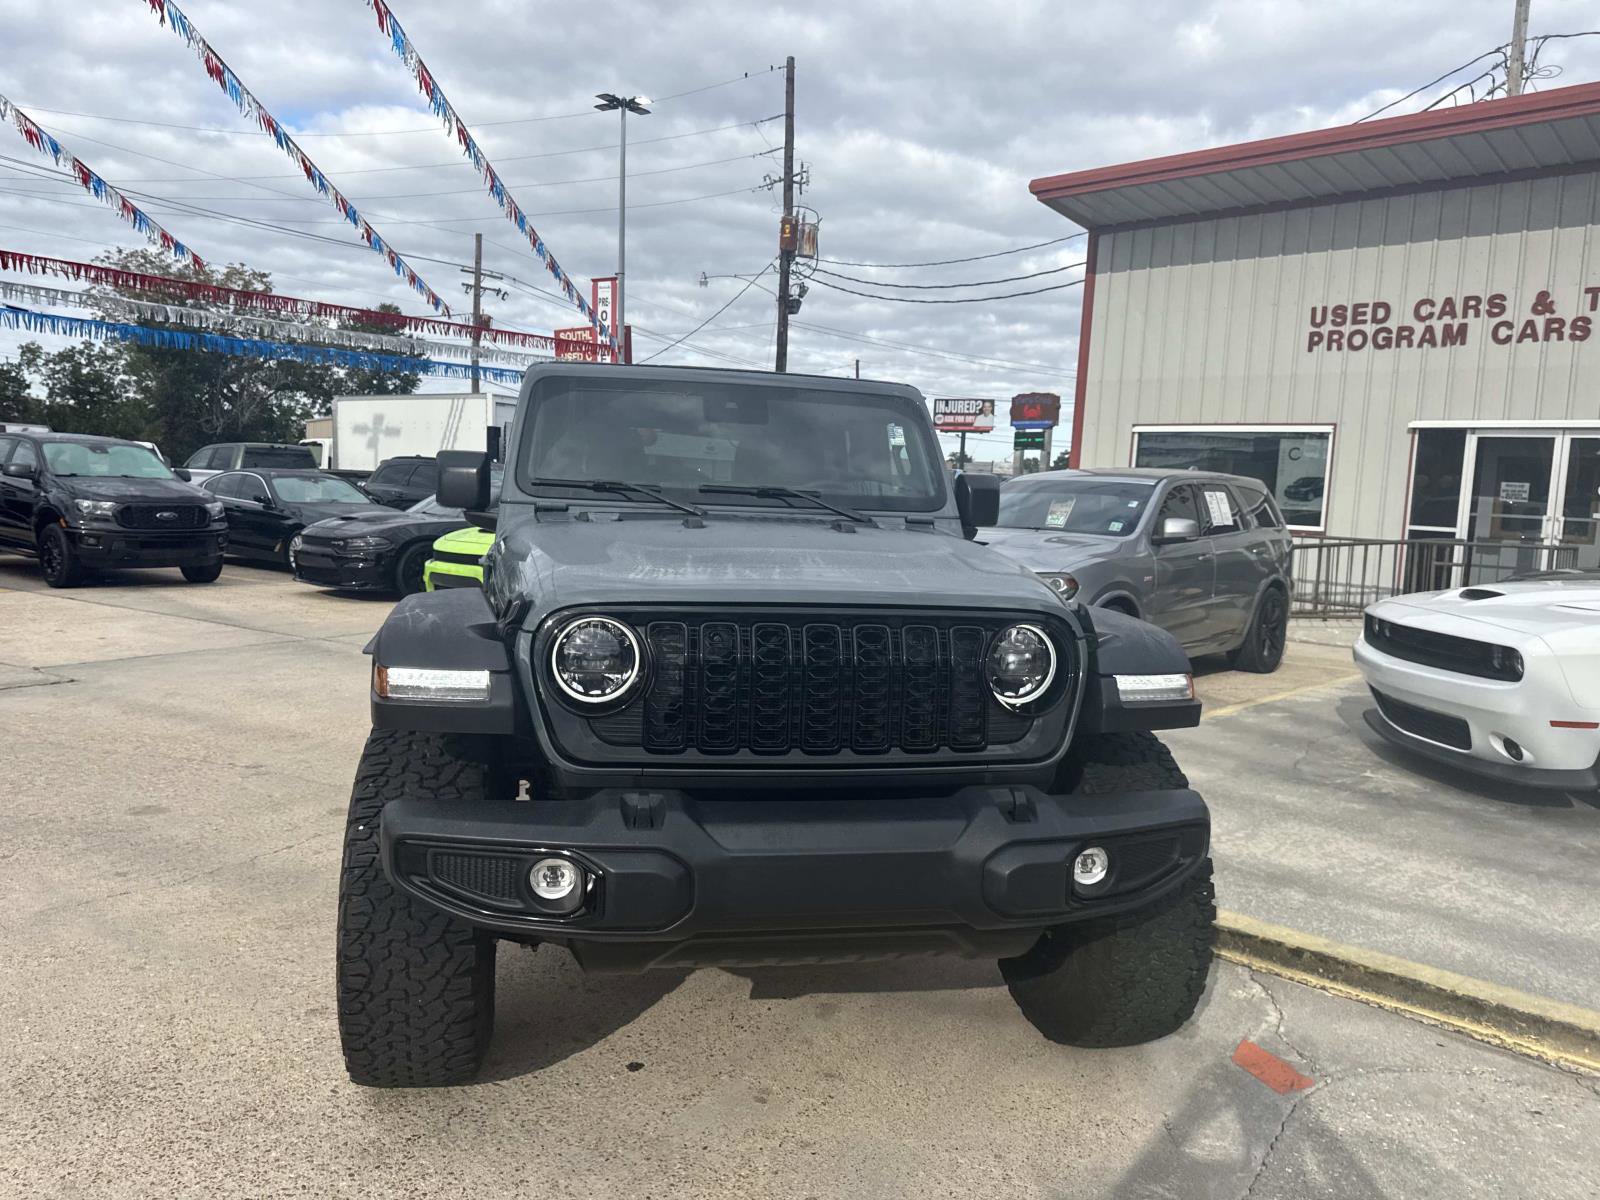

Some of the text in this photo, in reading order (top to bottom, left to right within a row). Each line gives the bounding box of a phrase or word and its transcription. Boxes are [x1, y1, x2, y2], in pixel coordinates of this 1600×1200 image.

[1310, 302, 1391, 328] USED
[1413, 293, 1507, 322] CARS
[1530, 290, 1556, 316] &
[1307, 316, 1593, 353] PROGRAM CARS
[936, 400, 983, 414] INJURED?
